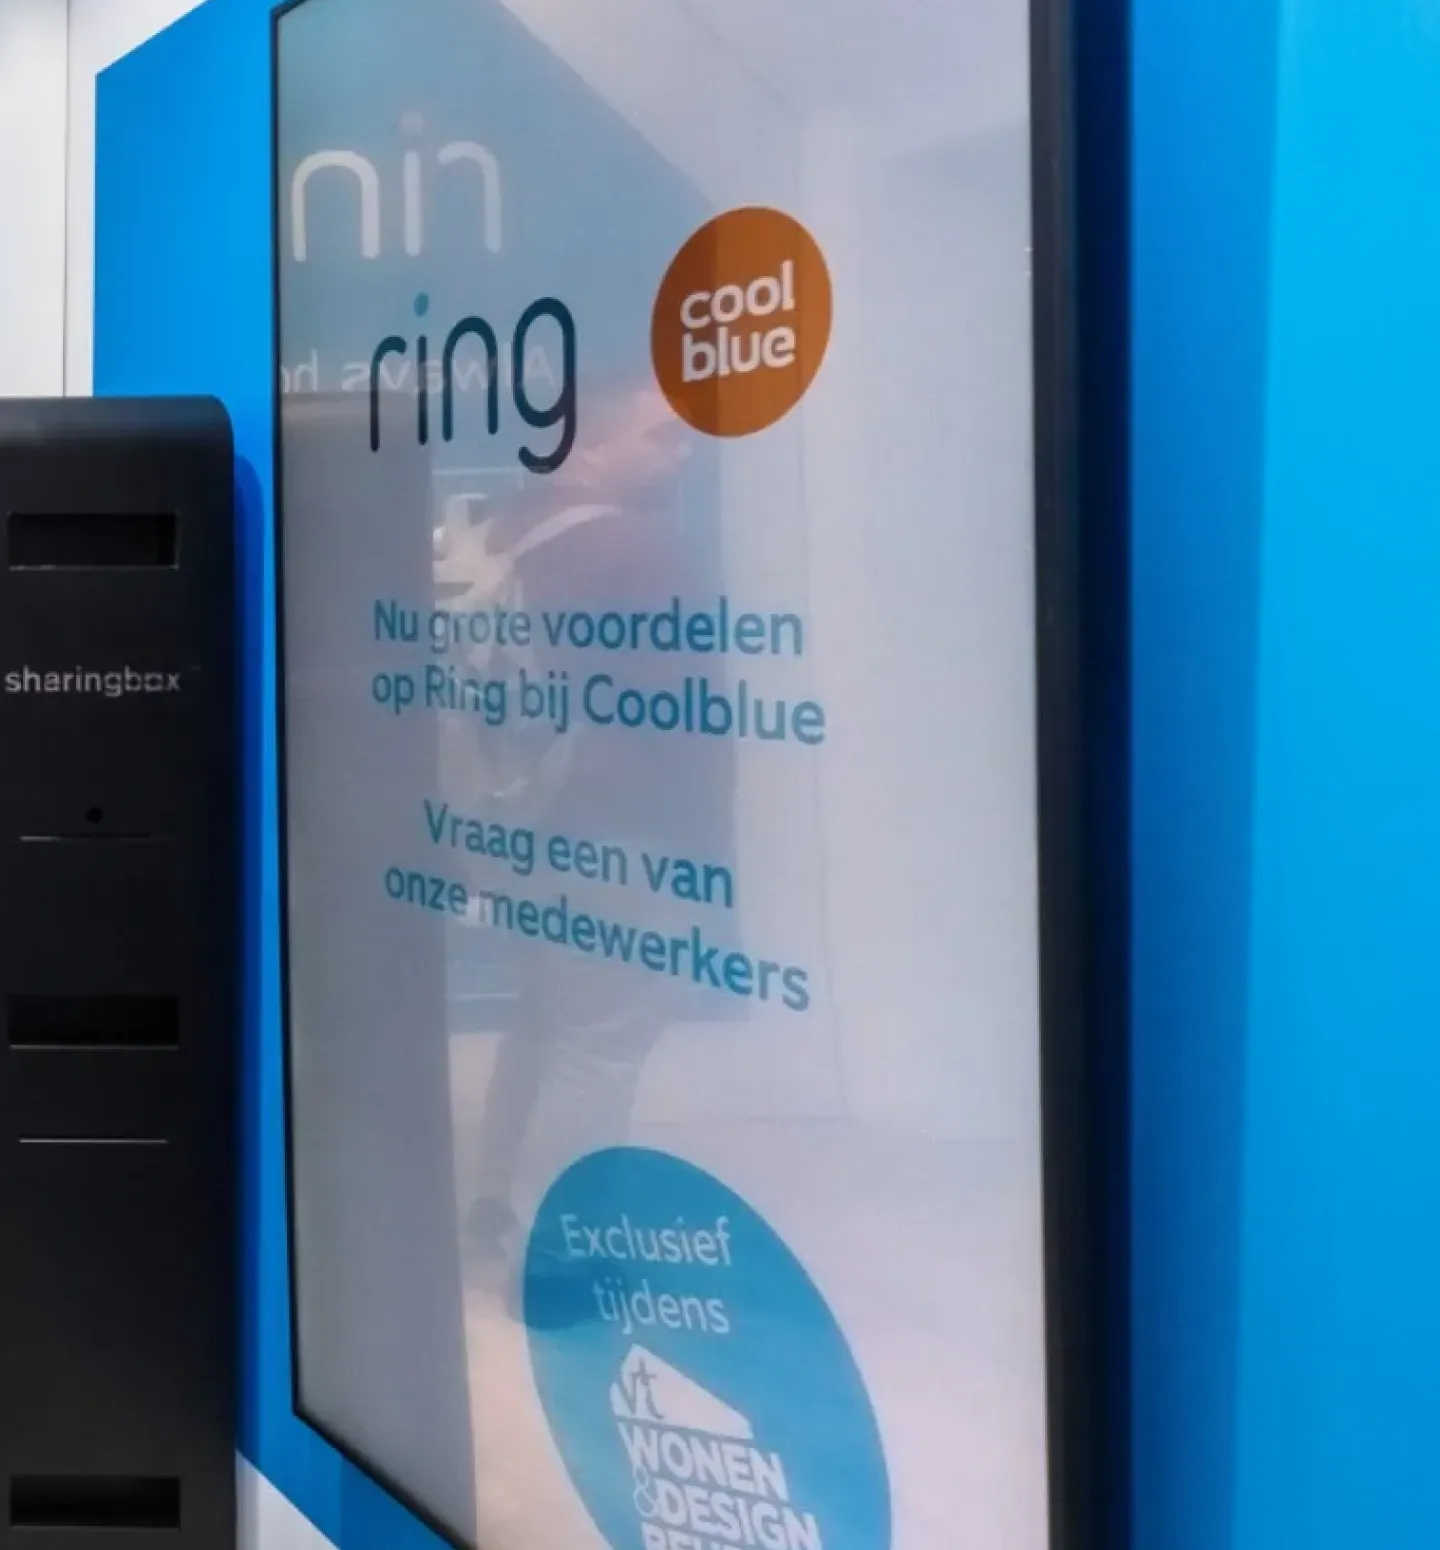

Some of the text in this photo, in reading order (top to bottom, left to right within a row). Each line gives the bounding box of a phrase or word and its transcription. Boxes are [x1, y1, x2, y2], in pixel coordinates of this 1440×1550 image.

[681, 259, 796, 330] cool
[370, 292, 577, 474] ring
[682, 326, 796, 383] blue
[373, 596, 803, 656] Nu grote voordelen
[4, 665, 181, 697] sharingbox
[371, 664, 826, 745] op Ring bij Coolblue
[423, 799, 735, 908] Vraag een van
[384, 865, 810, 1012] onze medewerkers
[560, 1213, 732, 1267] Exclusief
[592, 1277, 730, 1335] tijdens
[616, 1421, 790, 1501] WONEN
